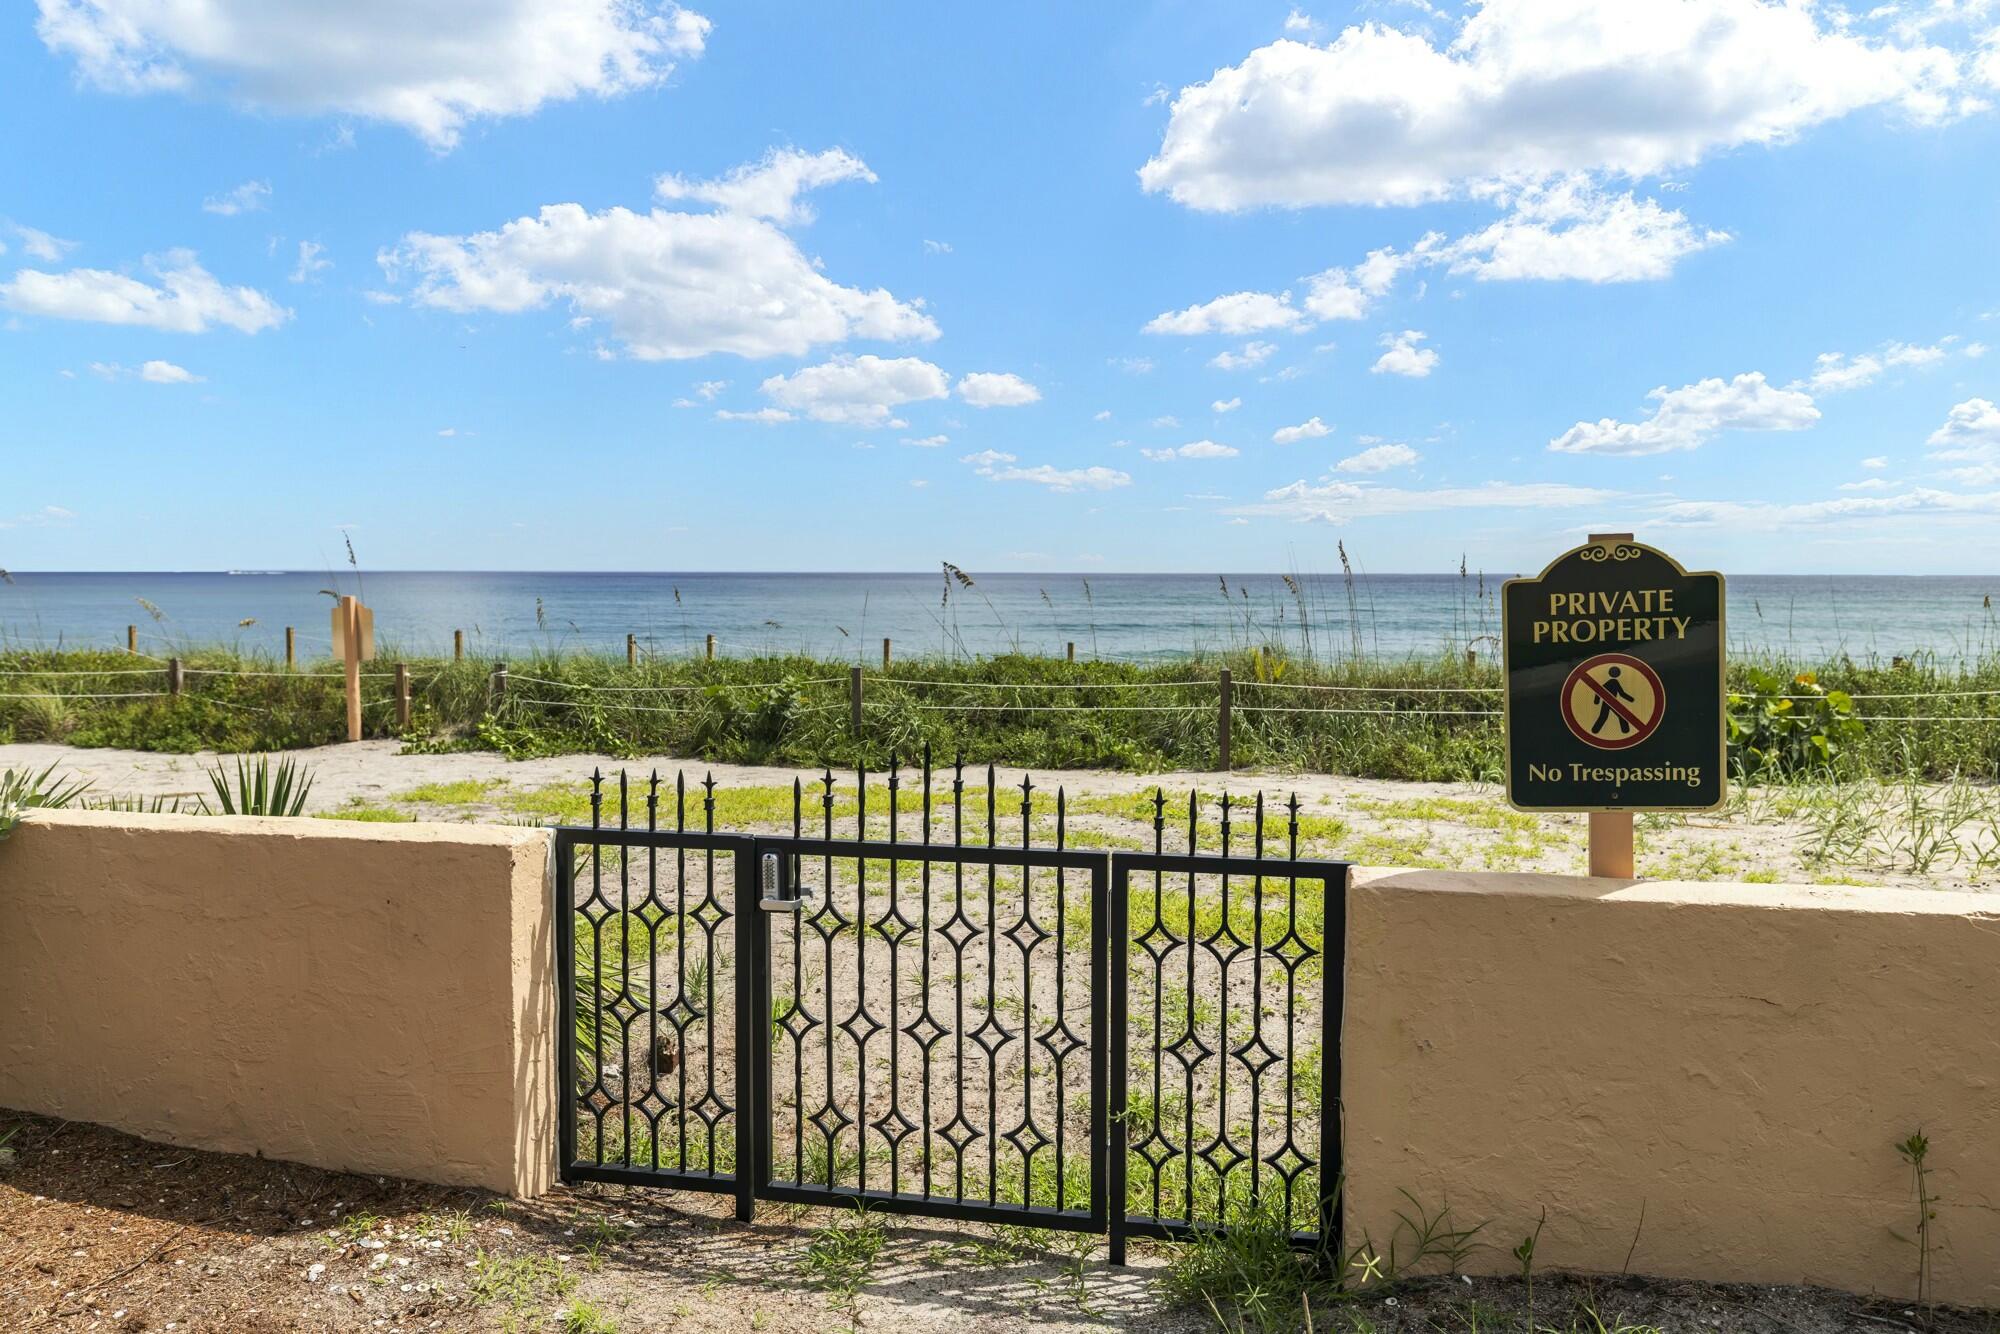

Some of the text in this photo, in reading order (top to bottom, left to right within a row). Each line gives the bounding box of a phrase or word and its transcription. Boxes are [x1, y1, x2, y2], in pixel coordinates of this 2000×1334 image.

[1550, 589, 1673, 616] PRIVATE
[1533, 616, 1691, 643] PROPERTY
[1529, 761, 1701, 788] No Trespassing
